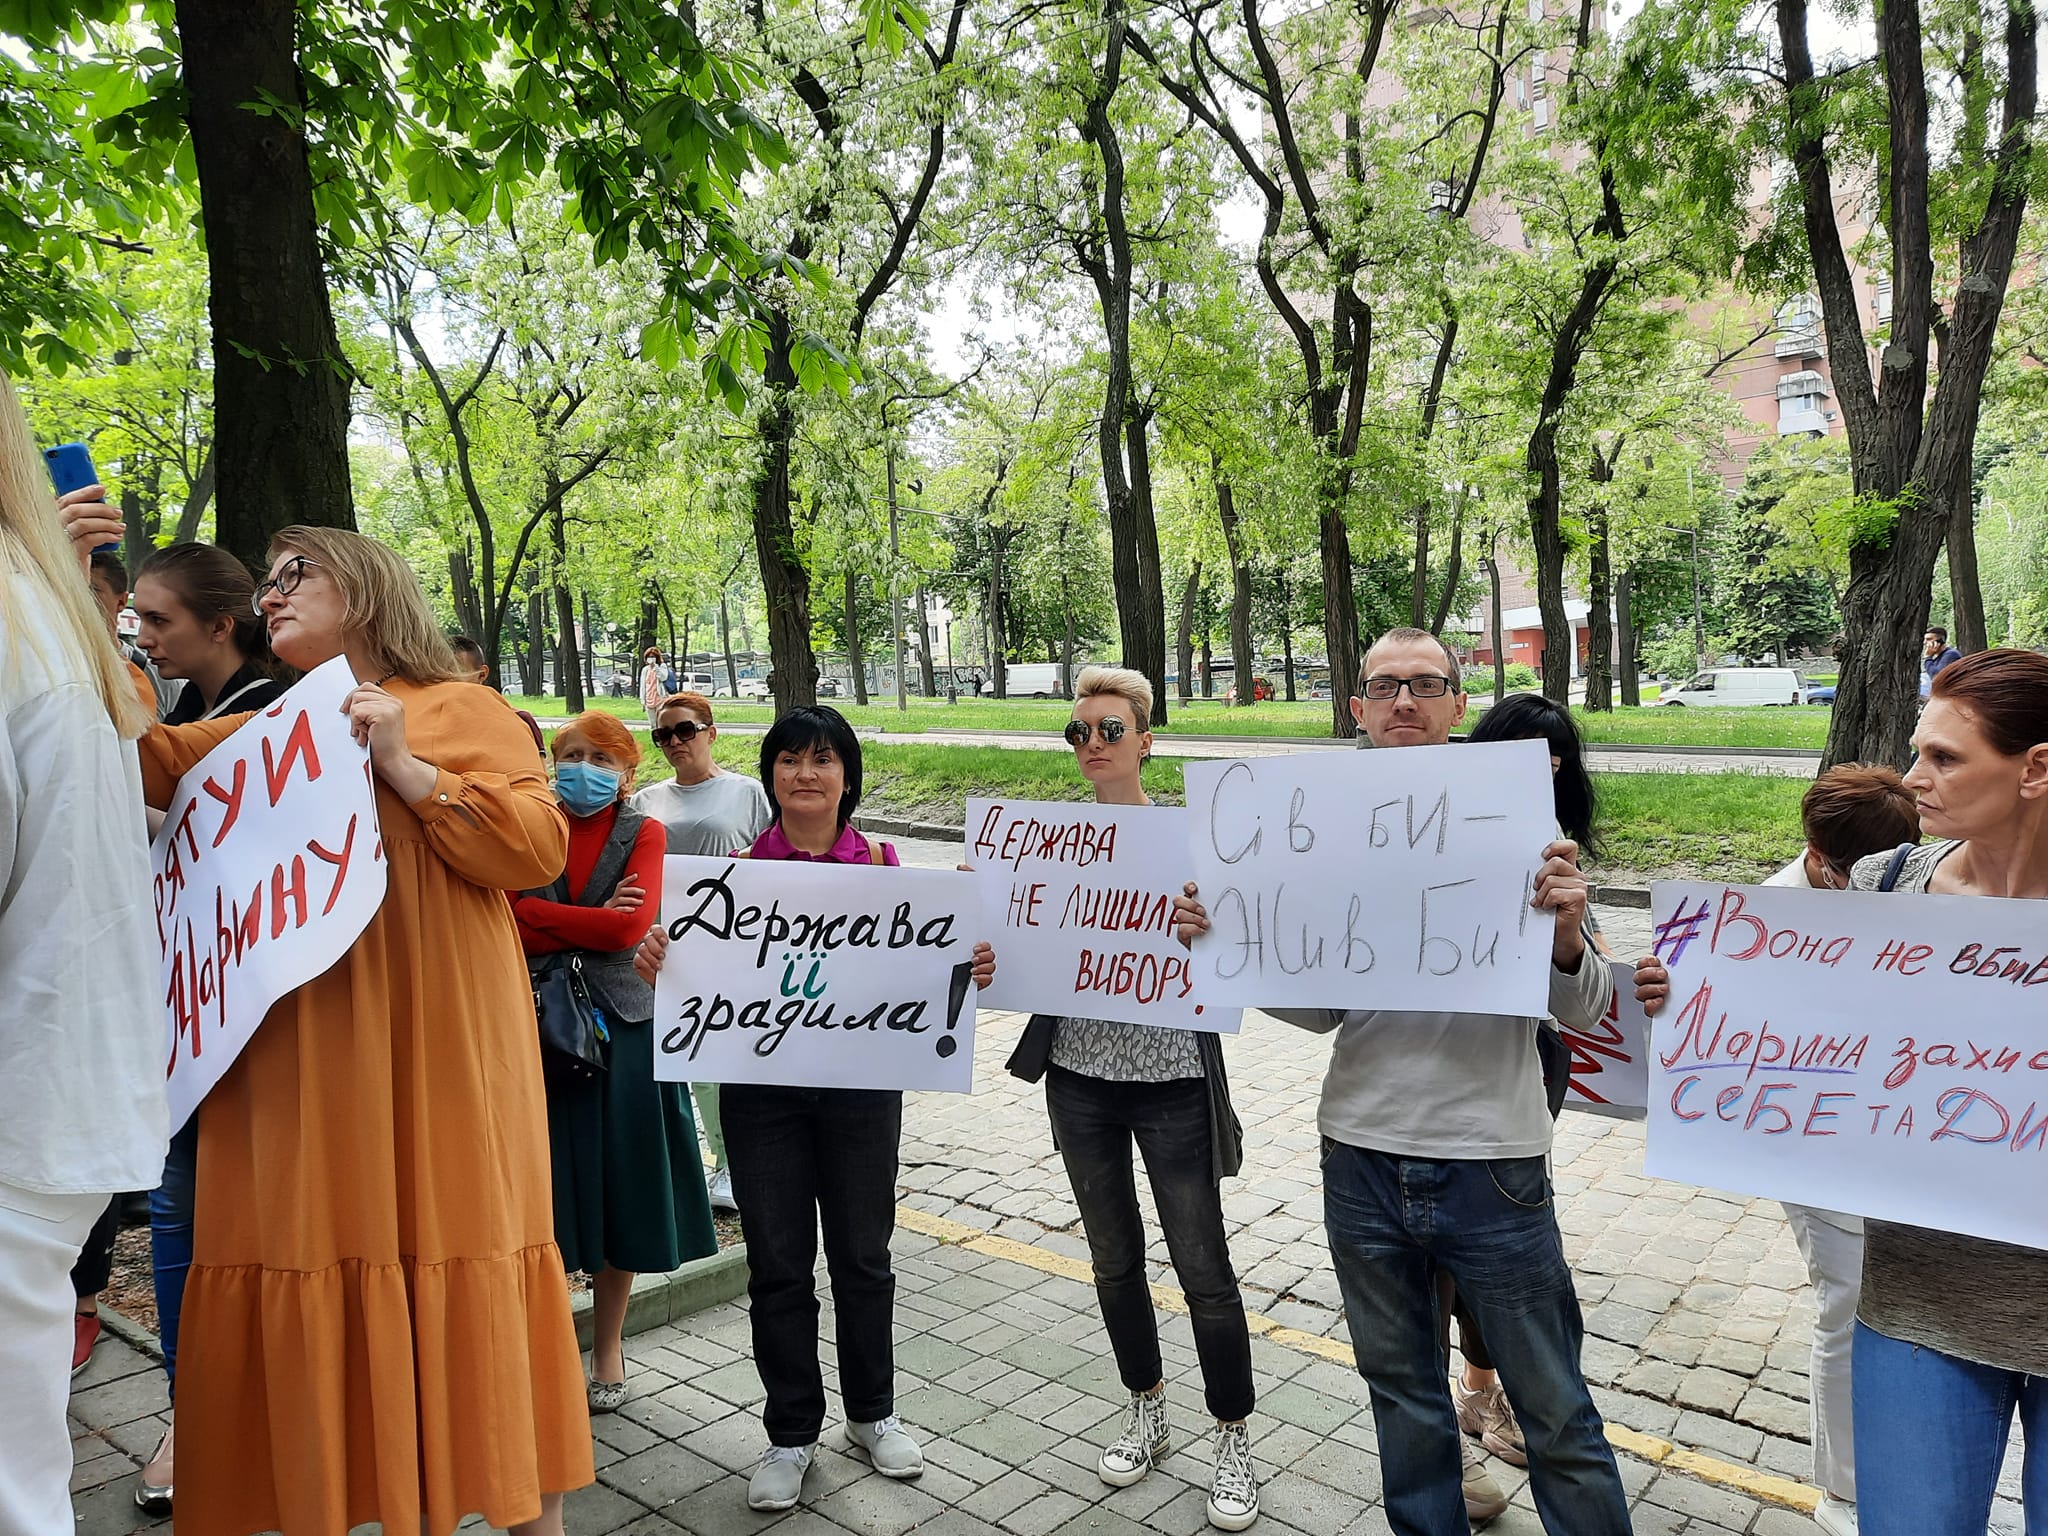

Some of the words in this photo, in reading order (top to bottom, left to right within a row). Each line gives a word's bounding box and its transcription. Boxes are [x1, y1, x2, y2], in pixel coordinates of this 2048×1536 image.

[975, 805, 1117, 872] ДЕРЖАВА
[668, 863, 957, 968] Держава
[1007, 882, 1047, 927] НЕ
[779, 951, 828, 999] її
[1872, 938, 1934, 976] не
[661, 961, 974, 1061] зрадила!
